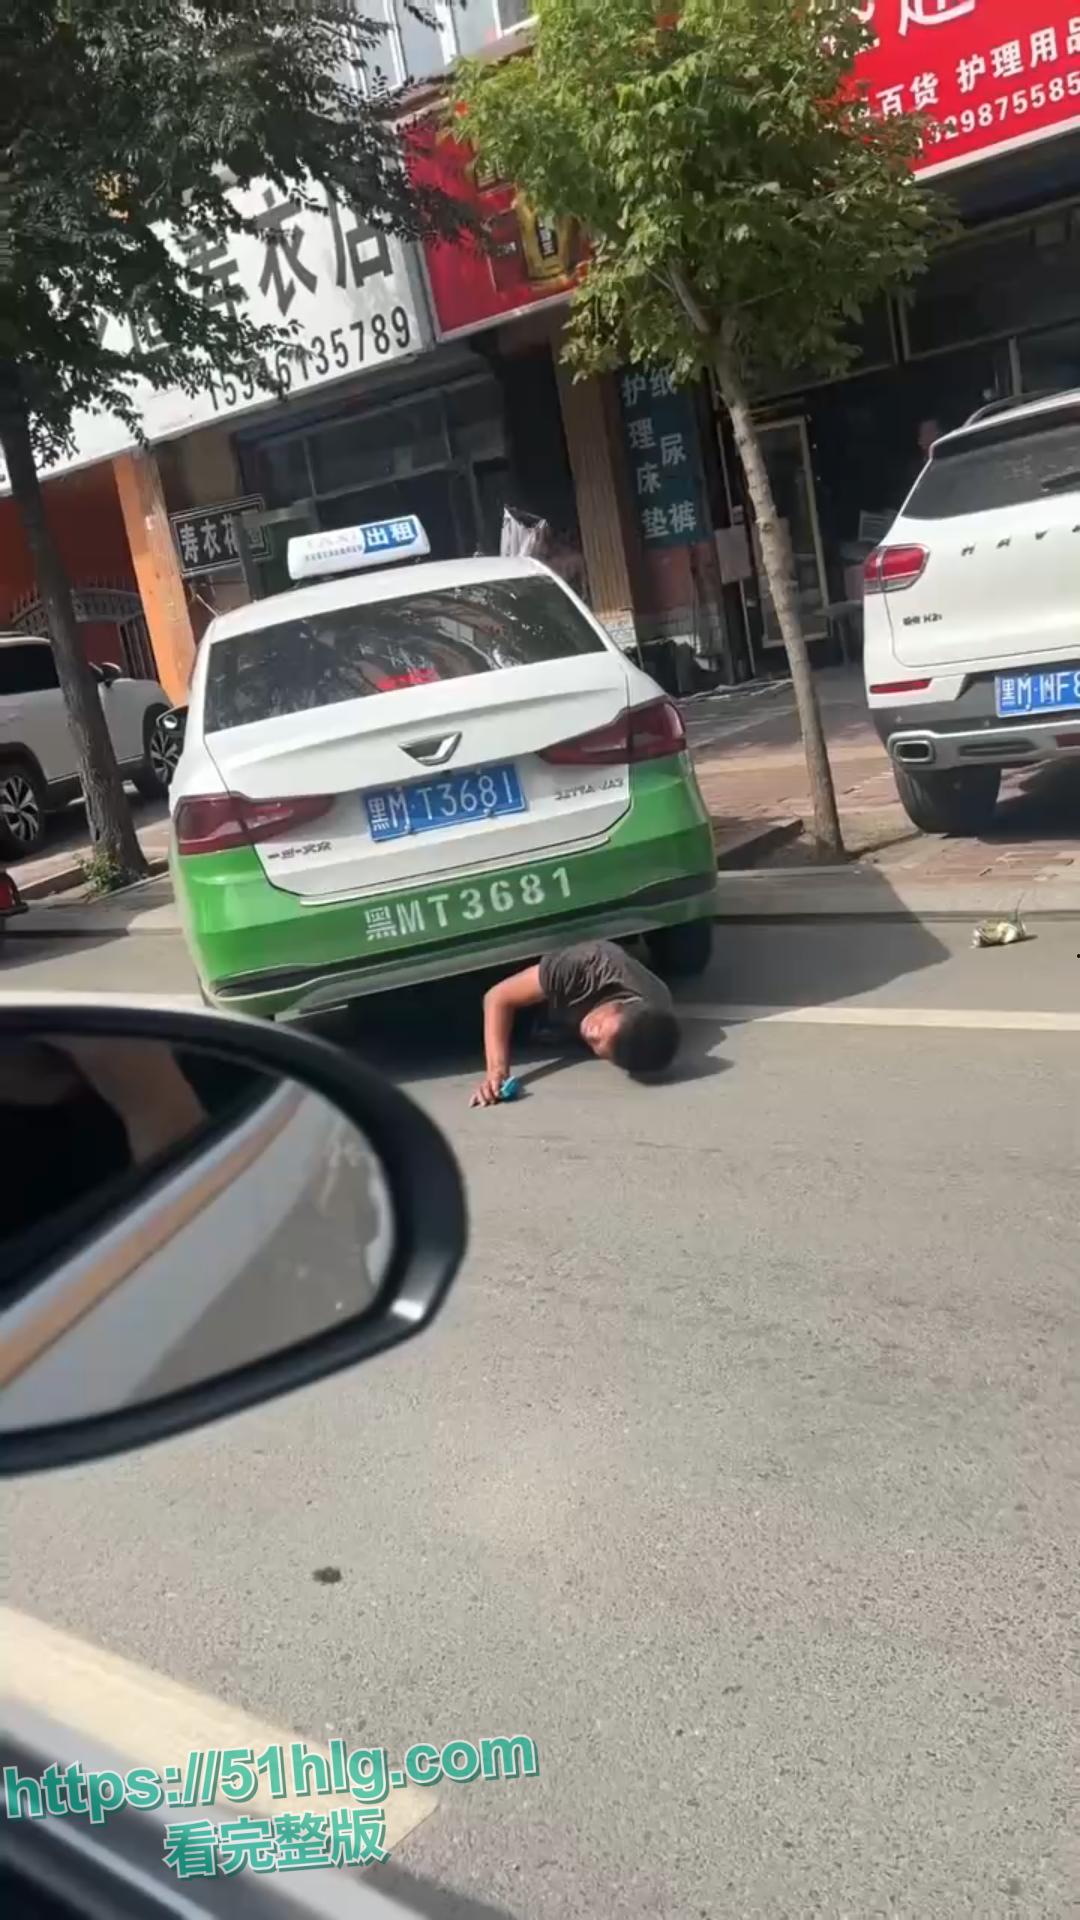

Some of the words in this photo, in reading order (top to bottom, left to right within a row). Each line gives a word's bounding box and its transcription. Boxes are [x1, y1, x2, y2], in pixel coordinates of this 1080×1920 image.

[850, 72, 939, 126] 百货
[206, 305, 411, 411] 1596135789
[622, 373, 669, 539] 护理床垫
[651, 364, 697, 534] 纸尿裤
[367, 521, 415, 546] 出租
[365, 866, 572, 941] 黑MT3681
